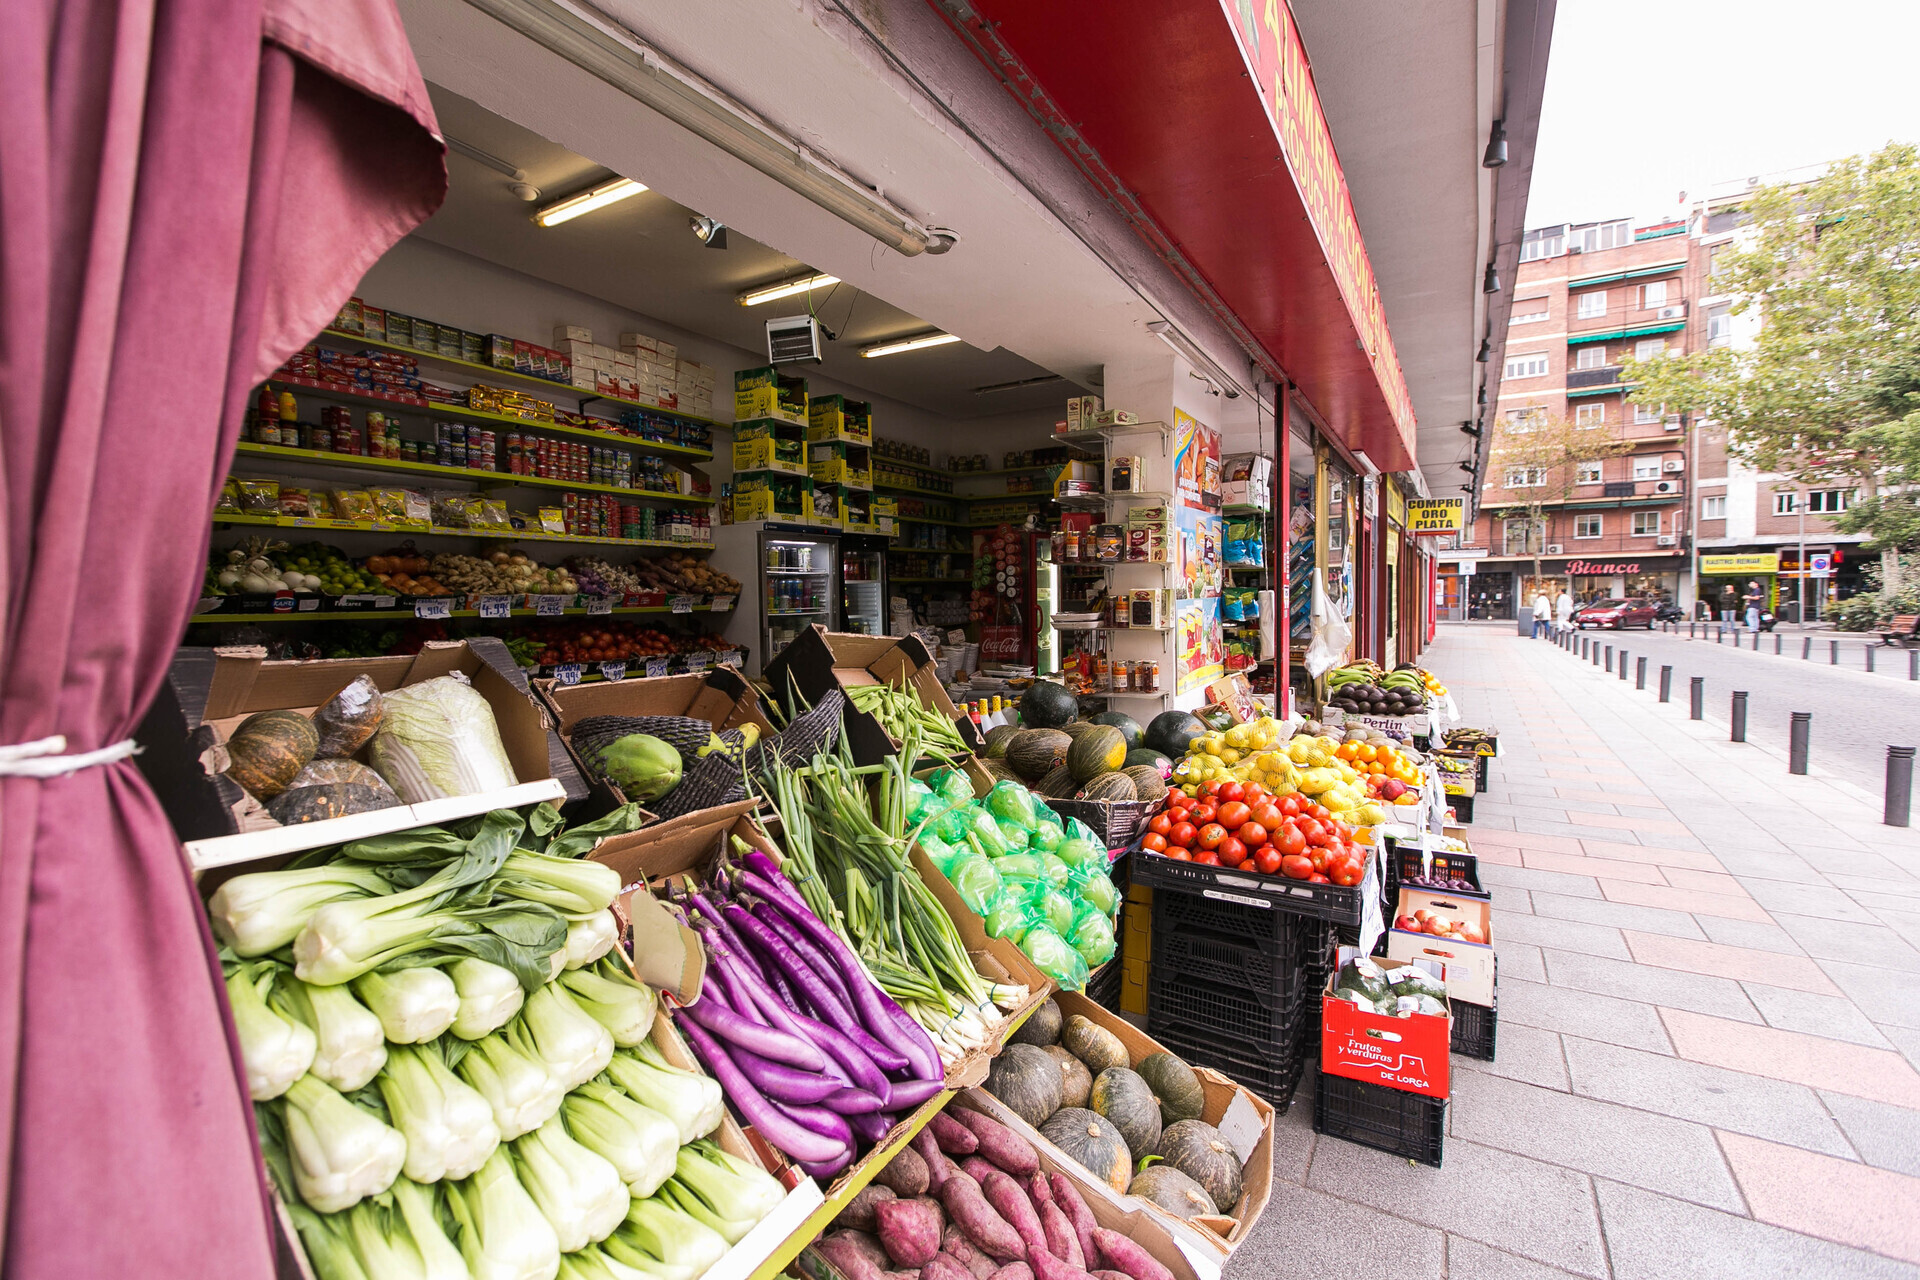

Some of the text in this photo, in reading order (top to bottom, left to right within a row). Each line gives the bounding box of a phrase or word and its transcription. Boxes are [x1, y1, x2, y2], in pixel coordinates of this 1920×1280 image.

[1264, 0, 1368, 309] ALIMENTACION
[1275, 70, 1335, 262] PRODUCTOS
[1408, 498, 1462, 509] COMPRO
[1422, 509, 1448, 518] ORO
[1416, 520, 1453, 529] PLATA
[1564, 560, 1640, 574] Bianca
[982, 638, 1020, 653] Coca-Cola
[1348, 1039, 1382, 1054] Frutas
[1338, 1046, 1392, 1064] y verduras
[1380, 1071, 1430, 1088] DE LORCA
